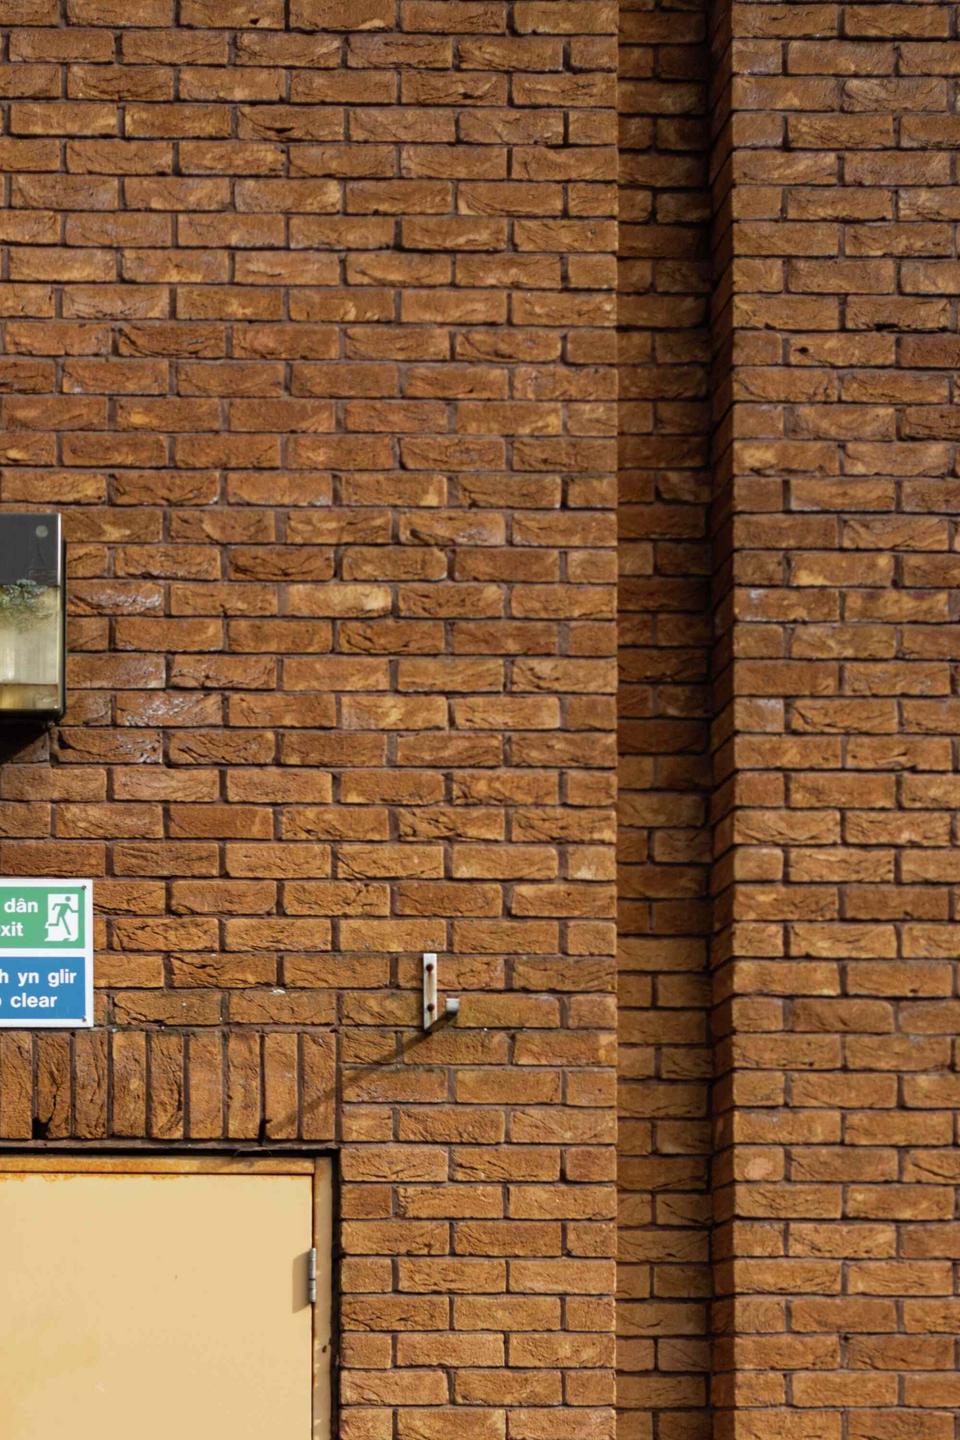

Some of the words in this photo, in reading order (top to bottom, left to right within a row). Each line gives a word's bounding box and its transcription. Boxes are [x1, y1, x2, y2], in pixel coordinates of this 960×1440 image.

[4, 897, 38, 913] dân
[17, 971, 39, 987] yn
[47, 968, 77, 987] glir
[10, 992, 58, 1008] clear
